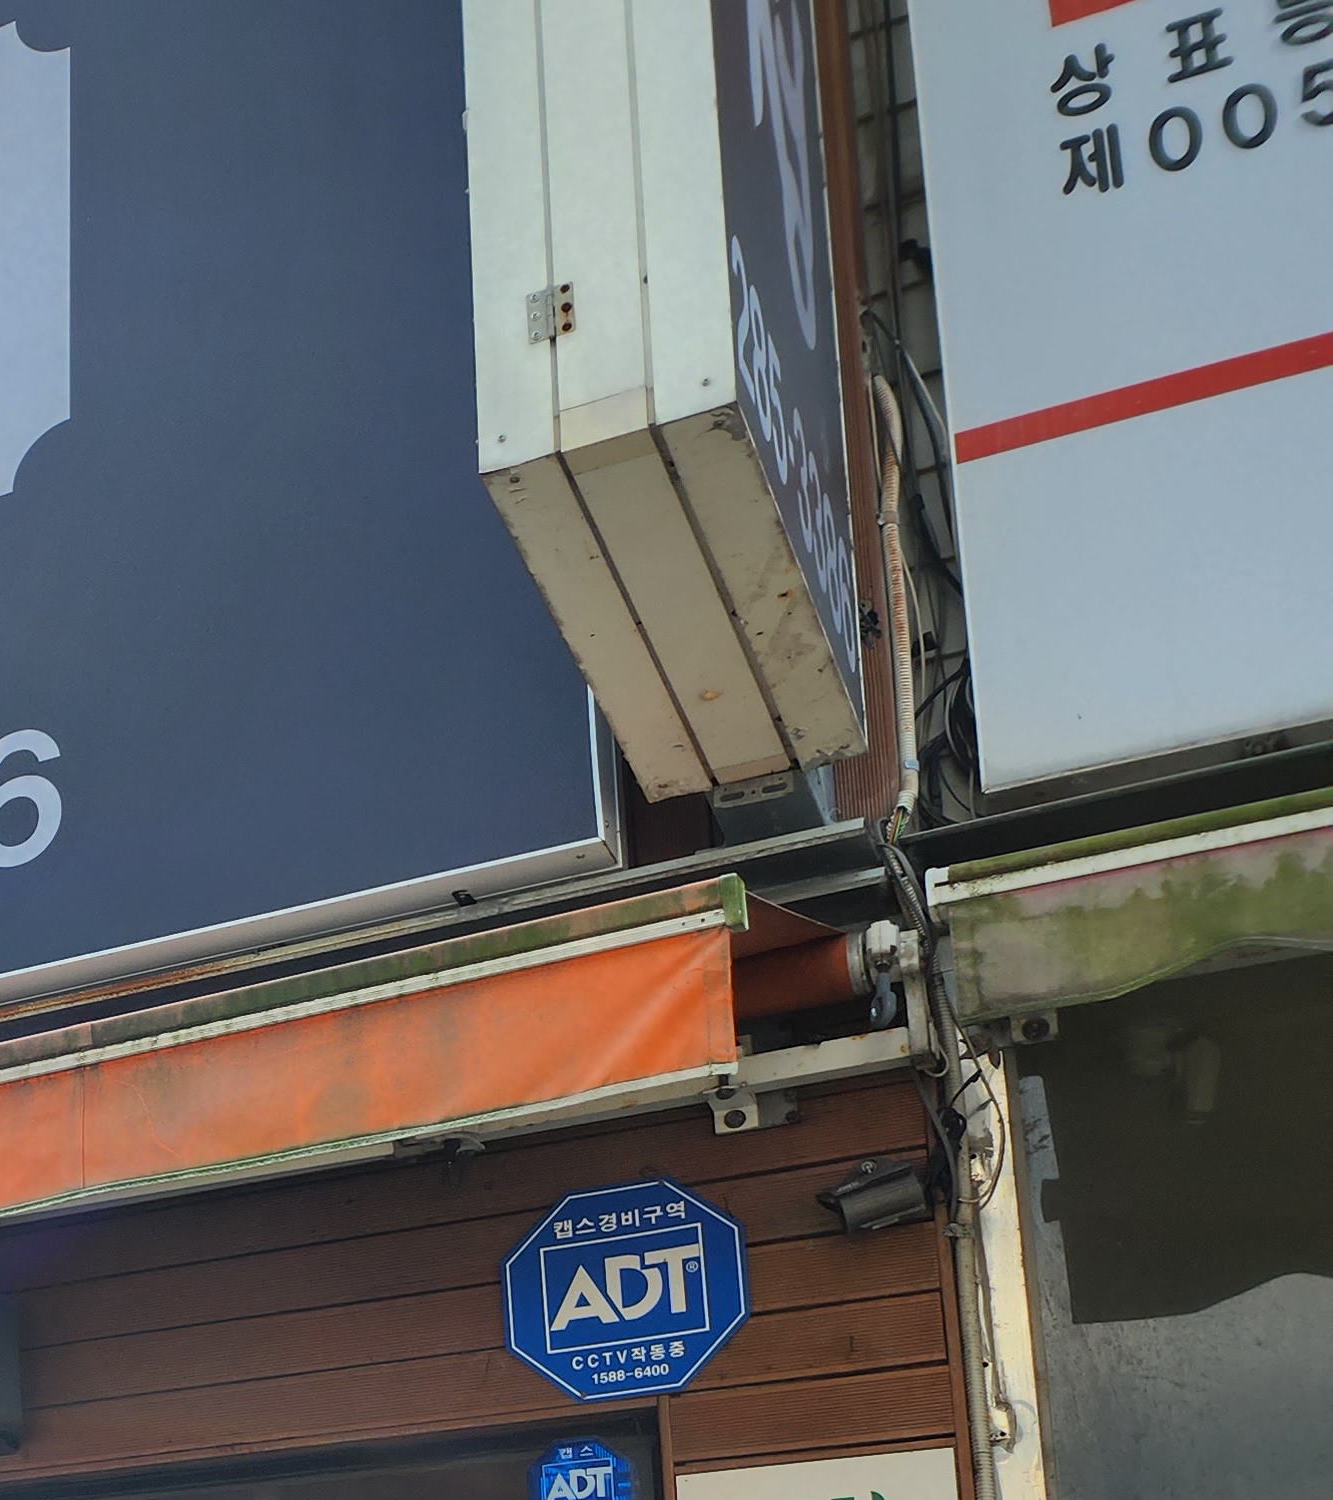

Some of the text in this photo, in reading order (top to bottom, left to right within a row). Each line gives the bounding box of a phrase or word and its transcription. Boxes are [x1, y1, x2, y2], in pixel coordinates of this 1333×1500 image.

[731, 235, 856, 672] 285-3386
[553, 1200, 686, 1239] 캡스경비구역
[550, 1243, 701, 1332] ADT
[572, 1341, 685, 1370] CCTV작동중
[592, 1363, 669, 1385] 1588-6400
